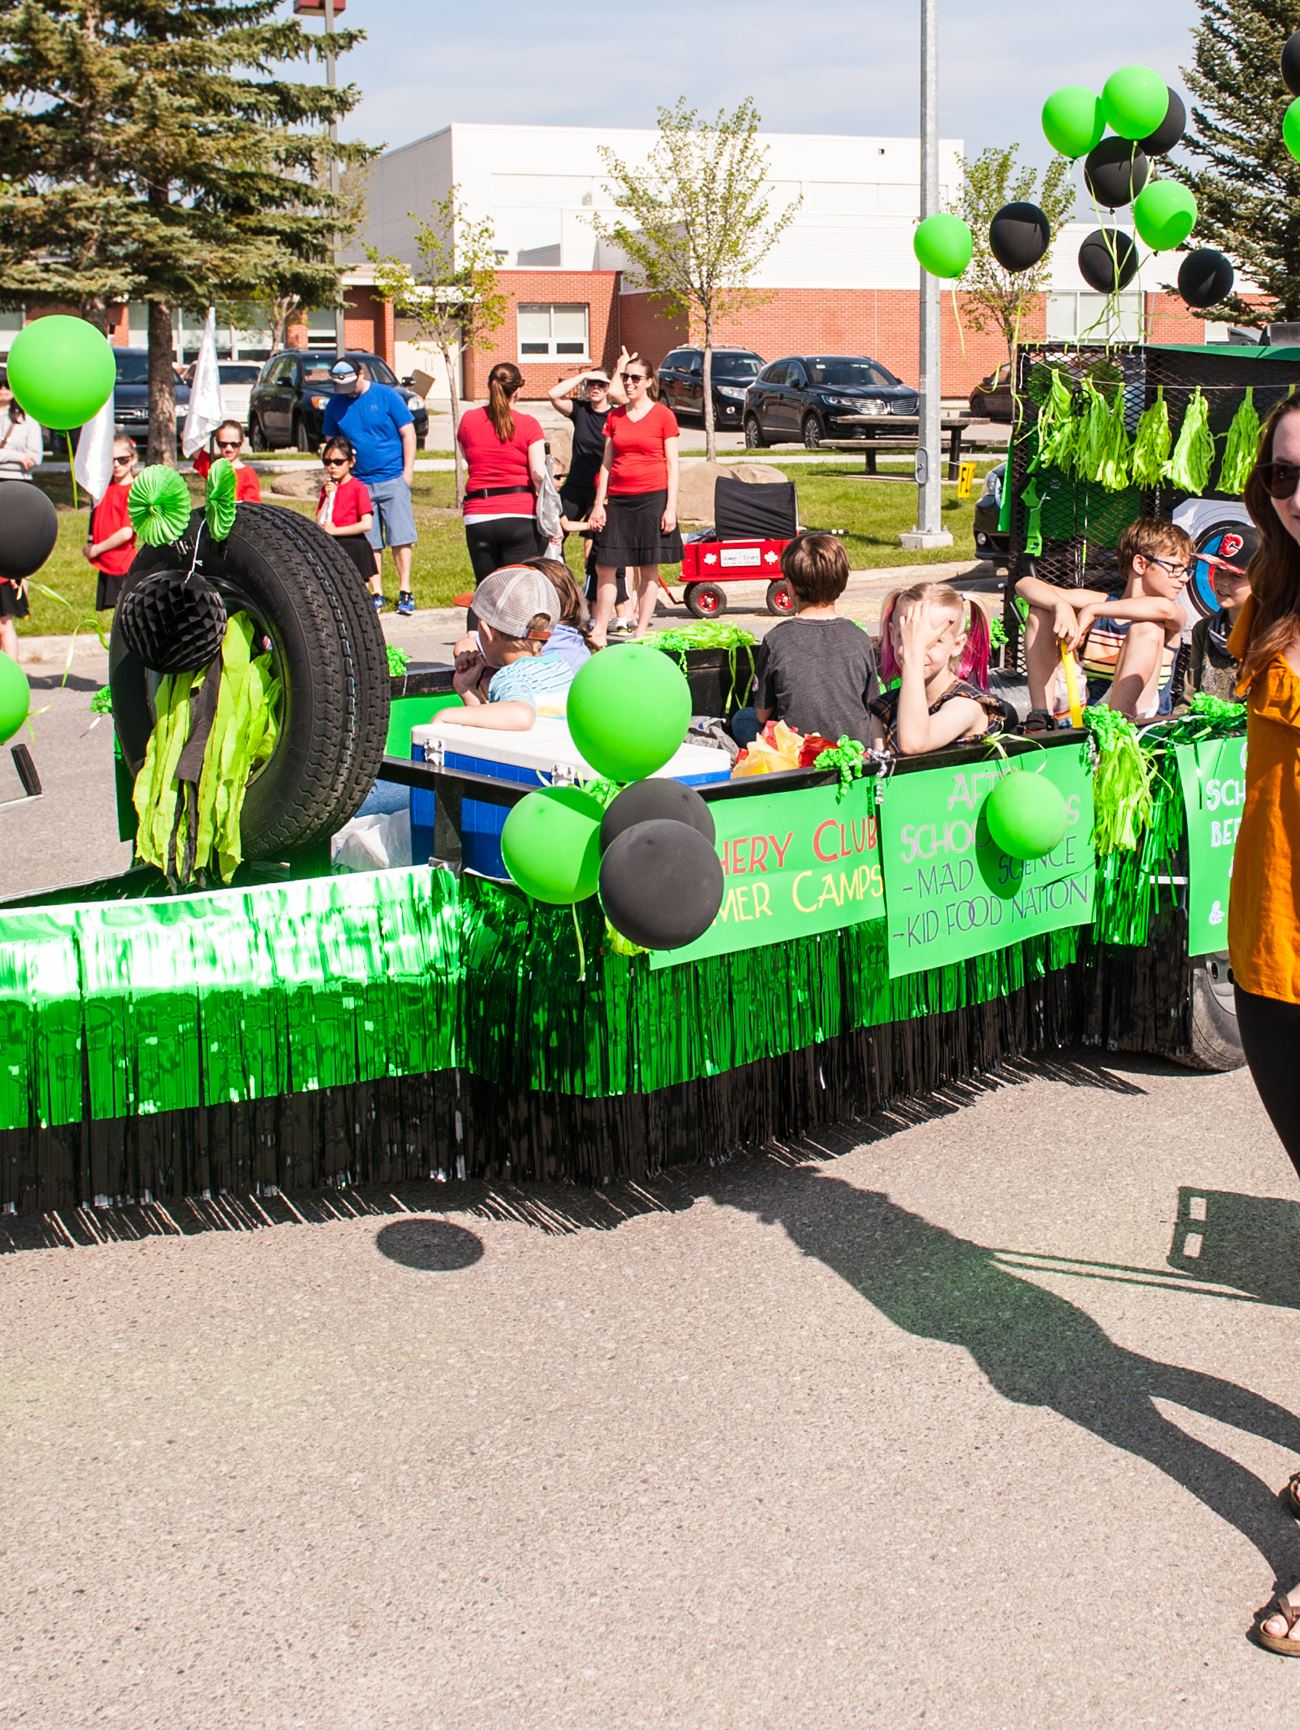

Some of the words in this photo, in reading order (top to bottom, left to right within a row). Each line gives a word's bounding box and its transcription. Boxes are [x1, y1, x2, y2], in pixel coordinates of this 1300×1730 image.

[947, 769, 1009, 811] AFT
[1207, 778, 1247, 811] SCH
[720, 831, 794, 876] HERY
[813, 815, 878, 863] CLUB
[901, 817, 992, 863] SCHOO
[712, 882, 774, 926] MER
[792, 864, 884, 913] CAMPS
[946, 895, 1003, 935] FOOD
[1011, 875, 1089, 923] NATION
